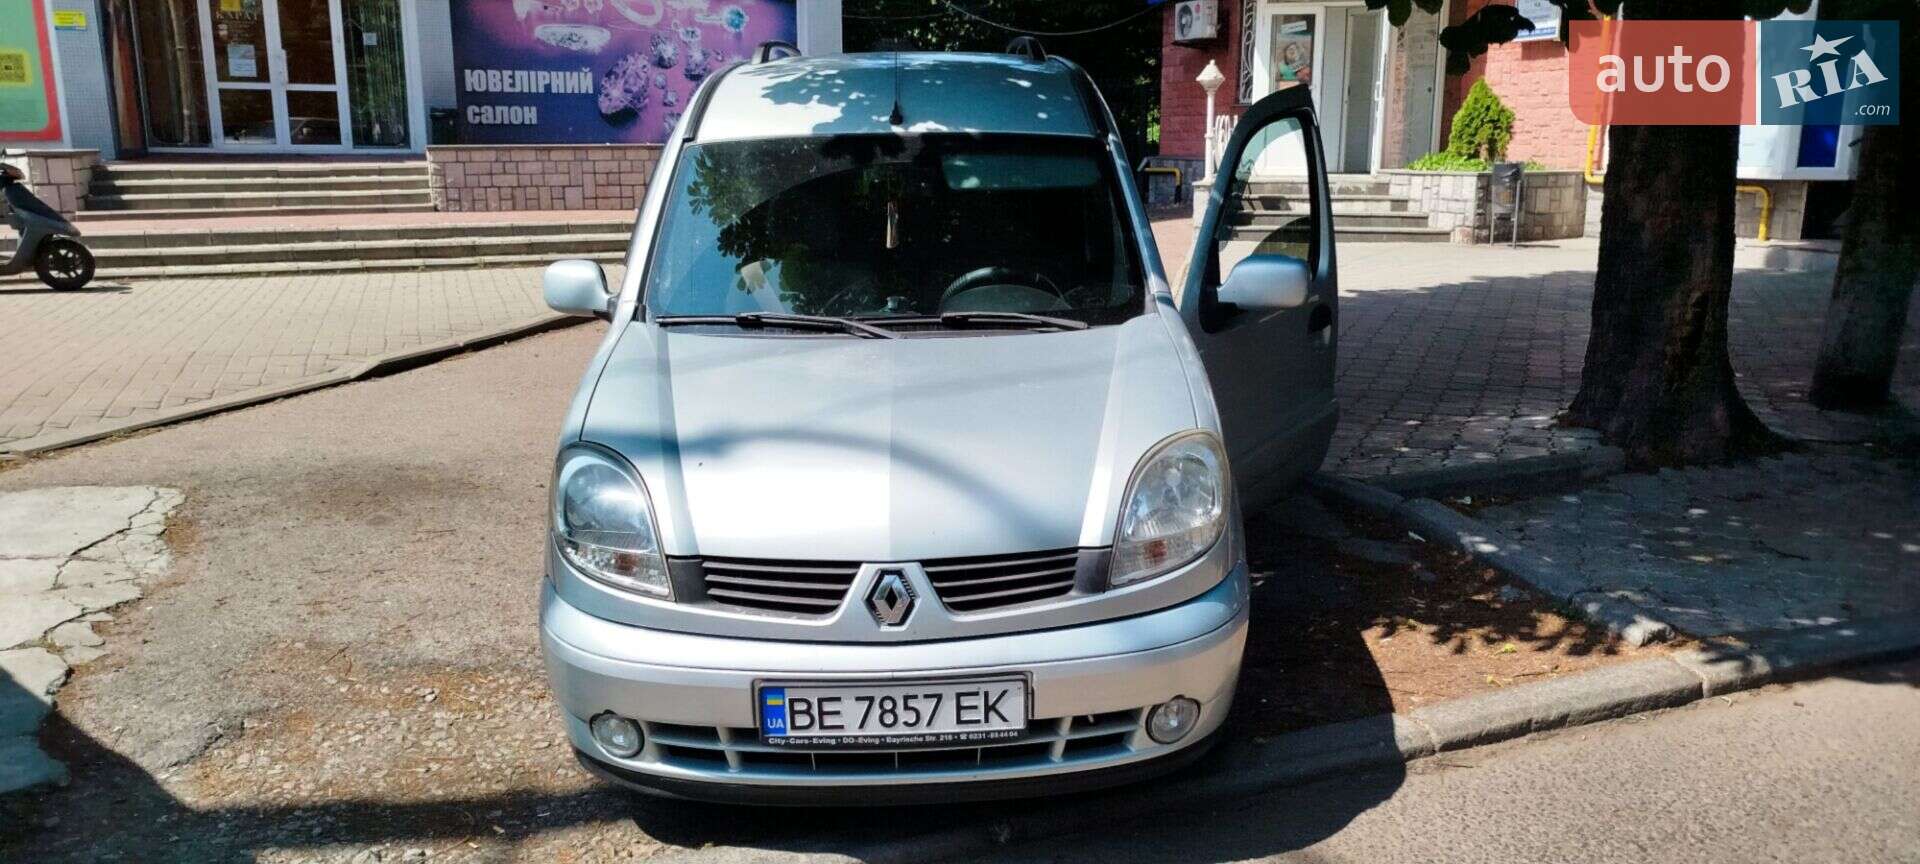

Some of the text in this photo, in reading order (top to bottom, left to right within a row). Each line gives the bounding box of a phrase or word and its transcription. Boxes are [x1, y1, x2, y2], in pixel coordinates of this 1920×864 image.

[464, 67, 593, 94] ЮВЕЛІРНИЙ
[466, 105, 538, 125] салон
[788, 689, 1009, 731] BE 7857 EK
[767, 718, 785, 729] UA
